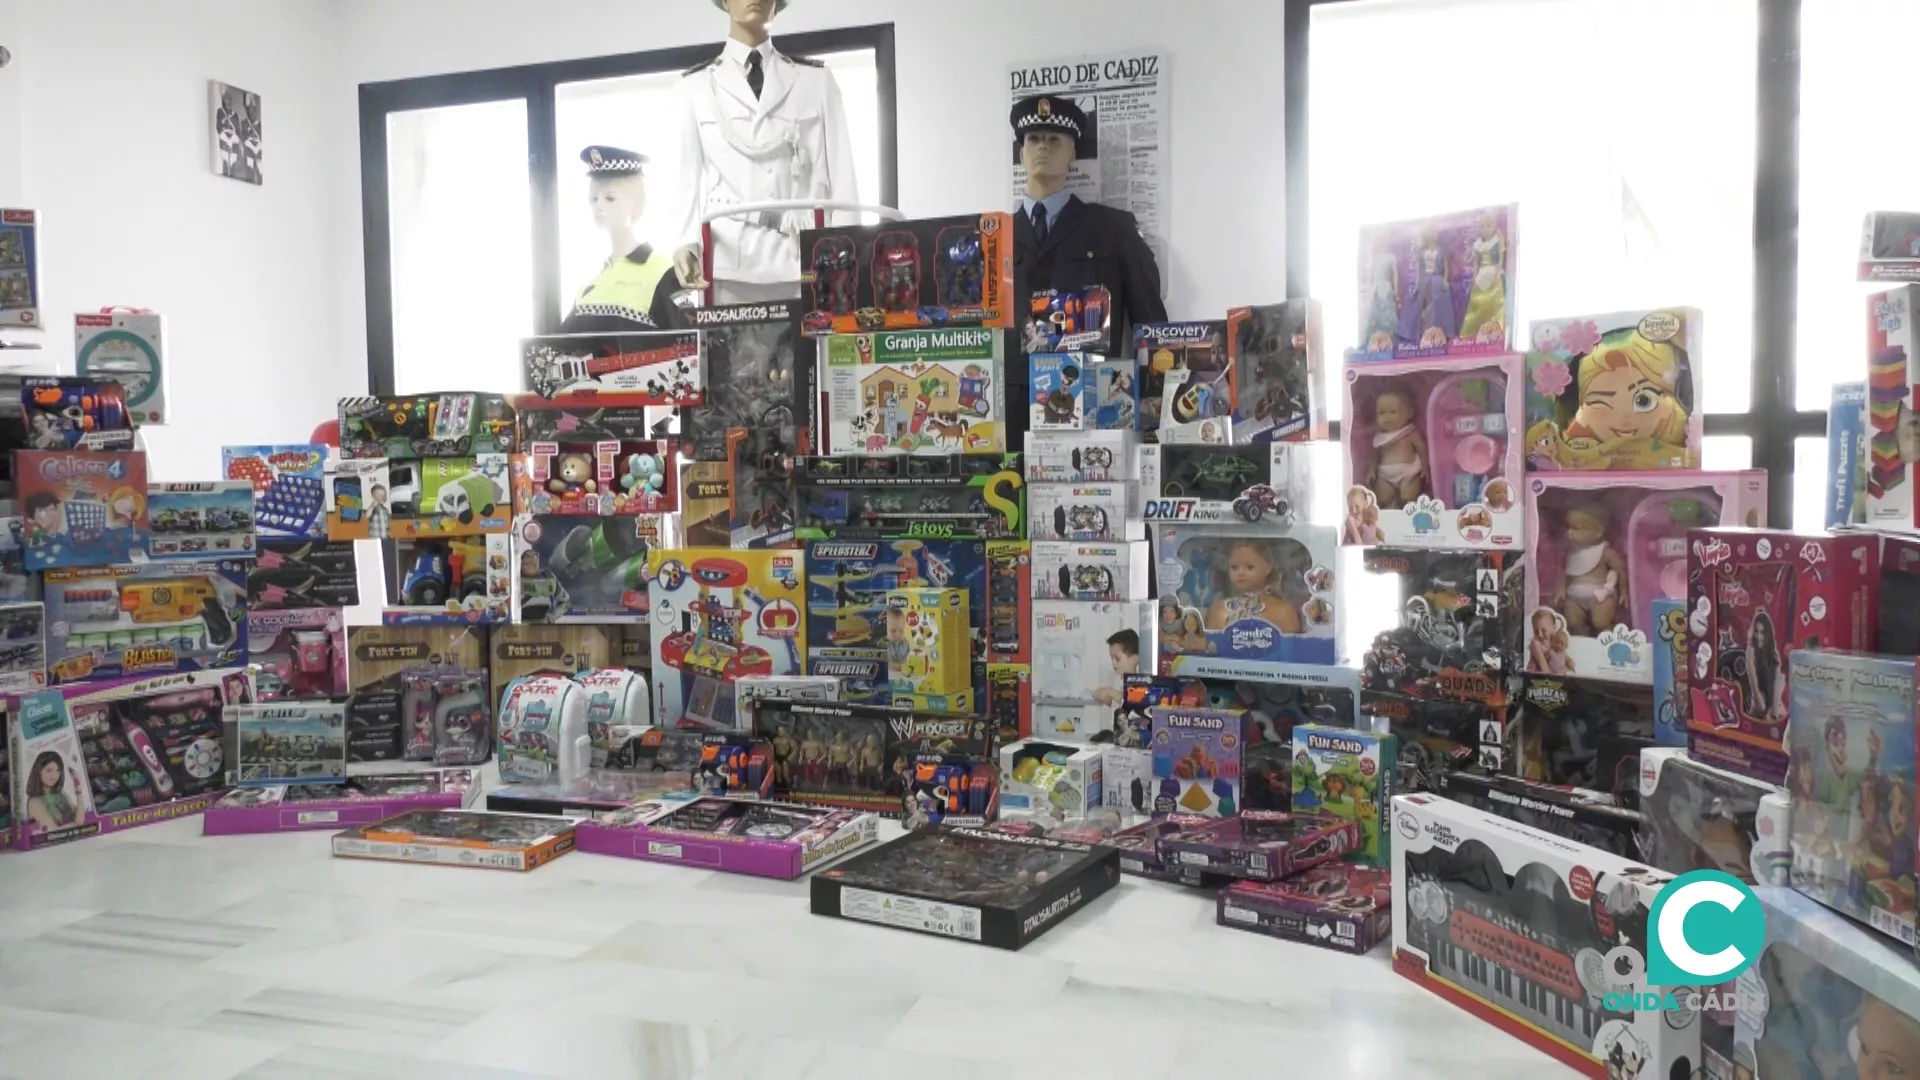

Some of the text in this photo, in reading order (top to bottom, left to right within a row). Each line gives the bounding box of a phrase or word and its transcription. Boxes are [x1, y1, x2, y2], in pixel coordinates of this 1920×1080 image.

[1011, 55, 1159, 90] DIARIO DE CADIZ
[696, 306, 768, 324] DINOSAURIOS
[885, 332, 983, 352] Granja Multikit
[108, 459, 122, 478] 4
[698, 484, 729, 496] FORT-
[1143, 499, 1197, 519] DRIFT
[1193, 509, 1220, 520] KING
[124, 649, 176, 667] BLASTER
[1168, 716, 1223, 729] FUN SAND
[1308, 735, 1362, 753] FUN SAND
[1550, 804, 1575, 818] Power
[1023, 894, 1070, 935] DINOSAURIOS
